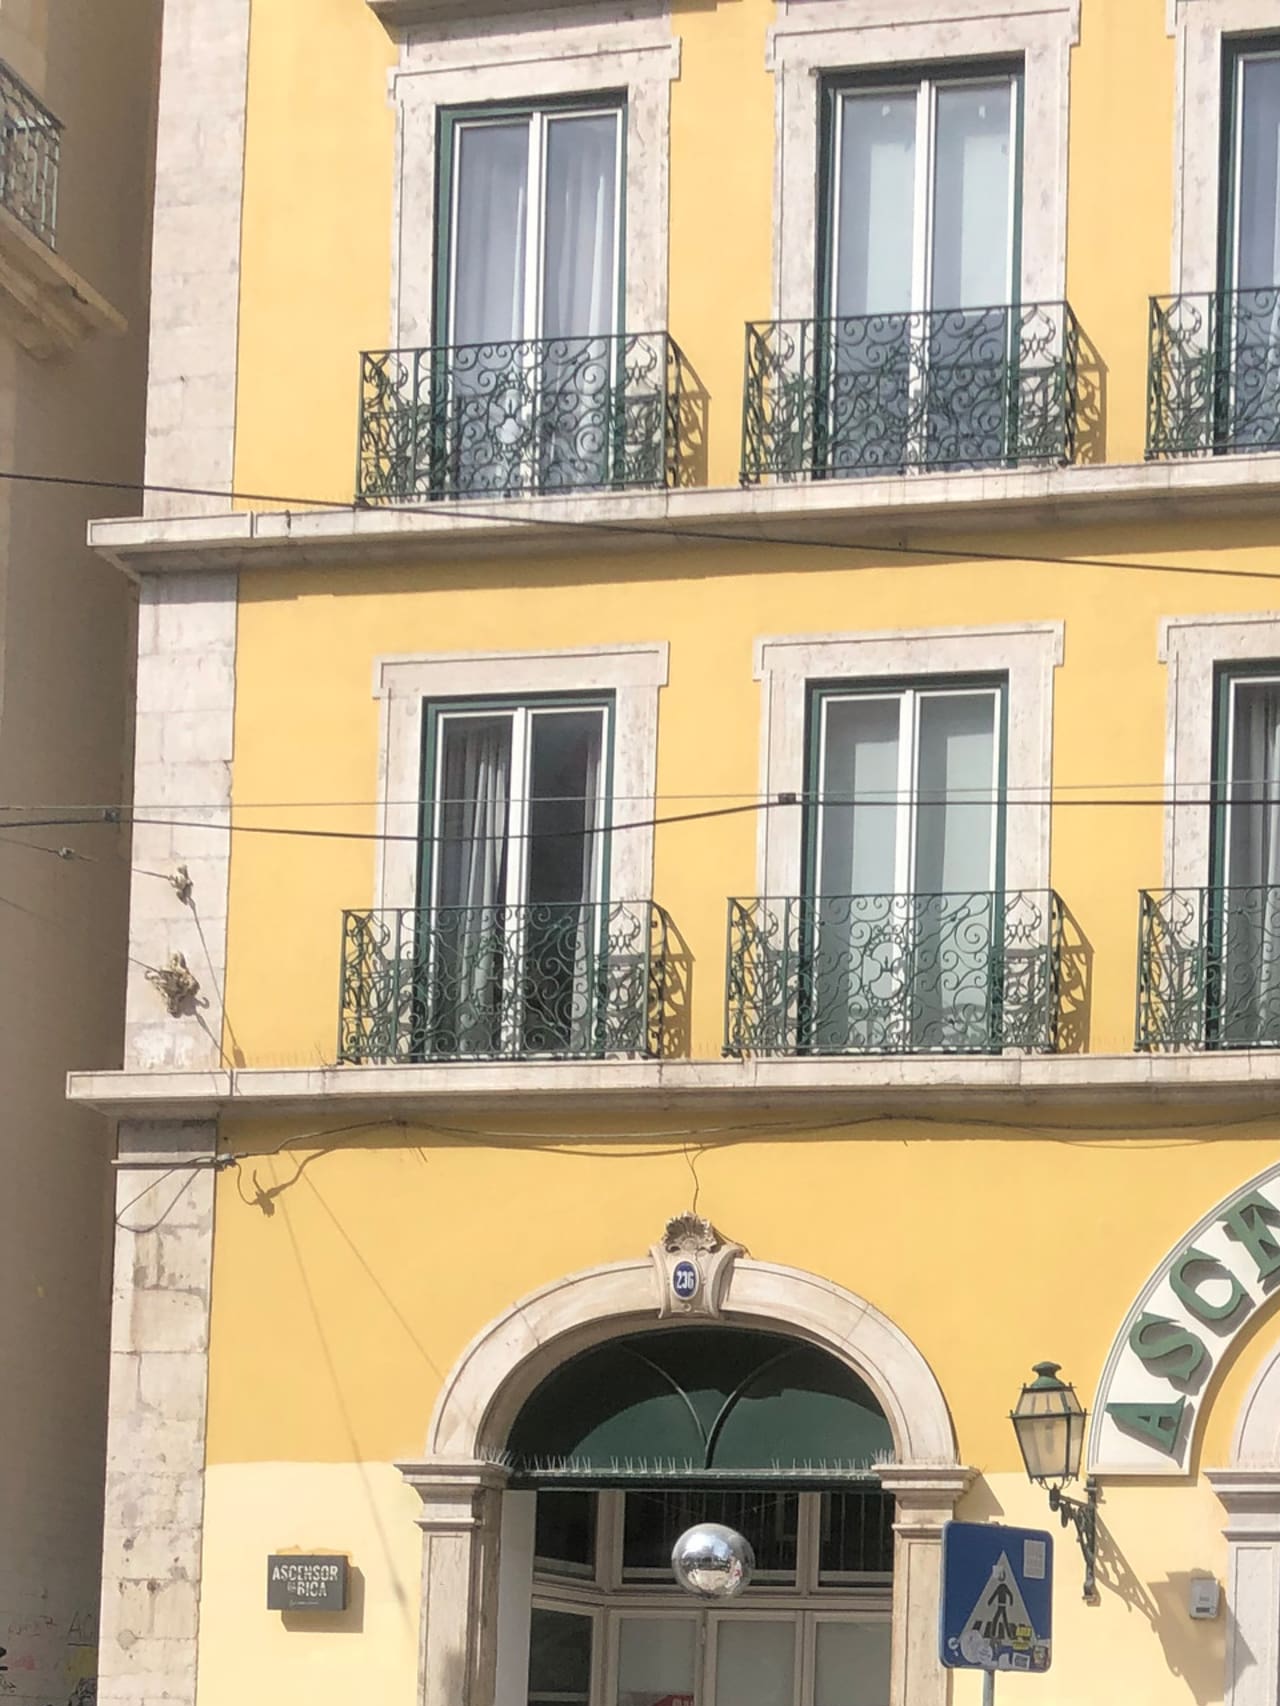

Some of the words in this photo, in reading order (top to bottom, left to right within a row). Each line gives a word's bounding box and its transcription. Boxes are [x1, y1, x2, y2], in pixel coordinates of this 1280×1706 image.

[676, 1271, 694, 1289] 236
[272, 1564, 338, 1581] ASCENSOR
[297, 1581, 327, 1597] BICA
